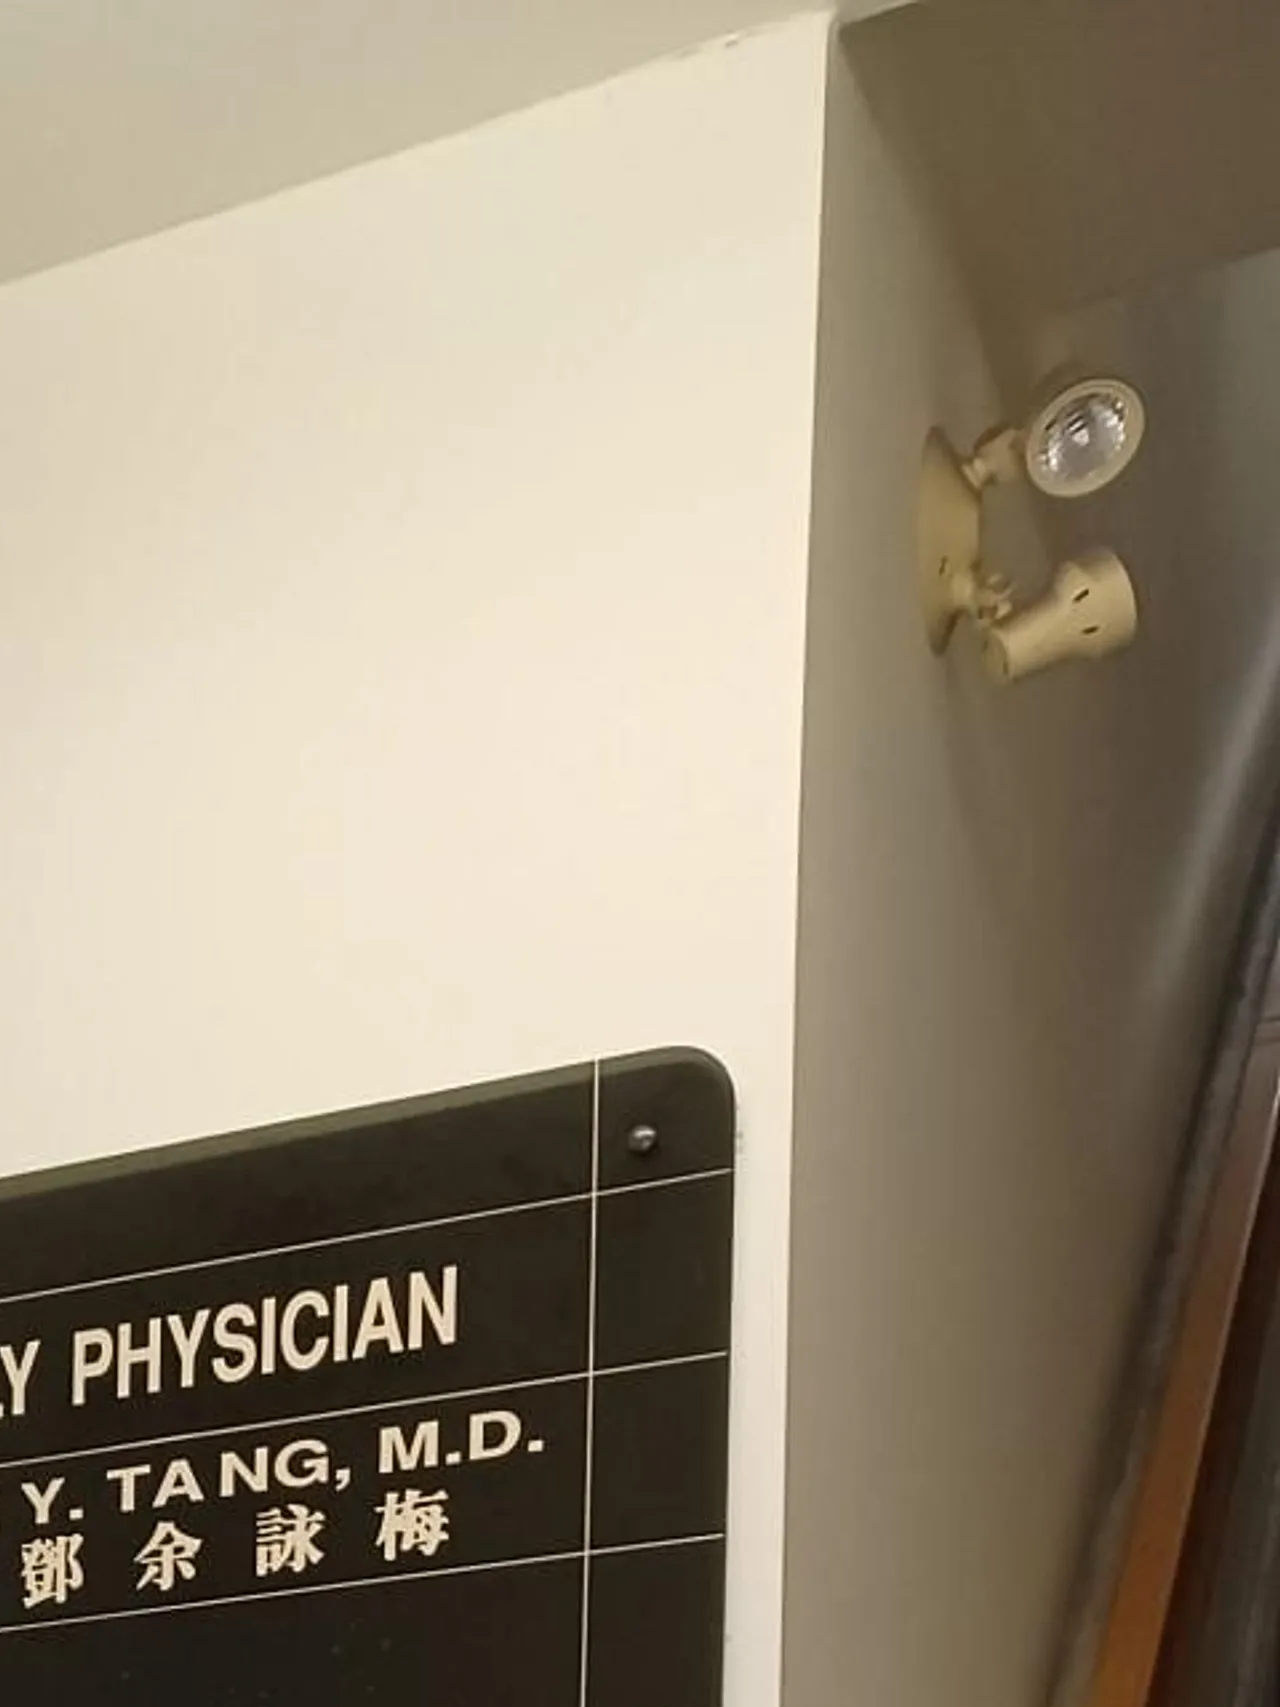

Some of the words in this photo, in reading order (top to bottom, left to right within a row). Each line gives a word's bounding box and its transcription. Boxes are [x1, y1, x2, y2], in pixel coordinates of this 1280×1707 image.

[72, 1265, 458, 1406] PHYSICIAN
[21, 1477, 84, 1525] Y.
[106, 1439, 351, 1512] TANG,
[378, 1410, 544, 1474] M.D.
